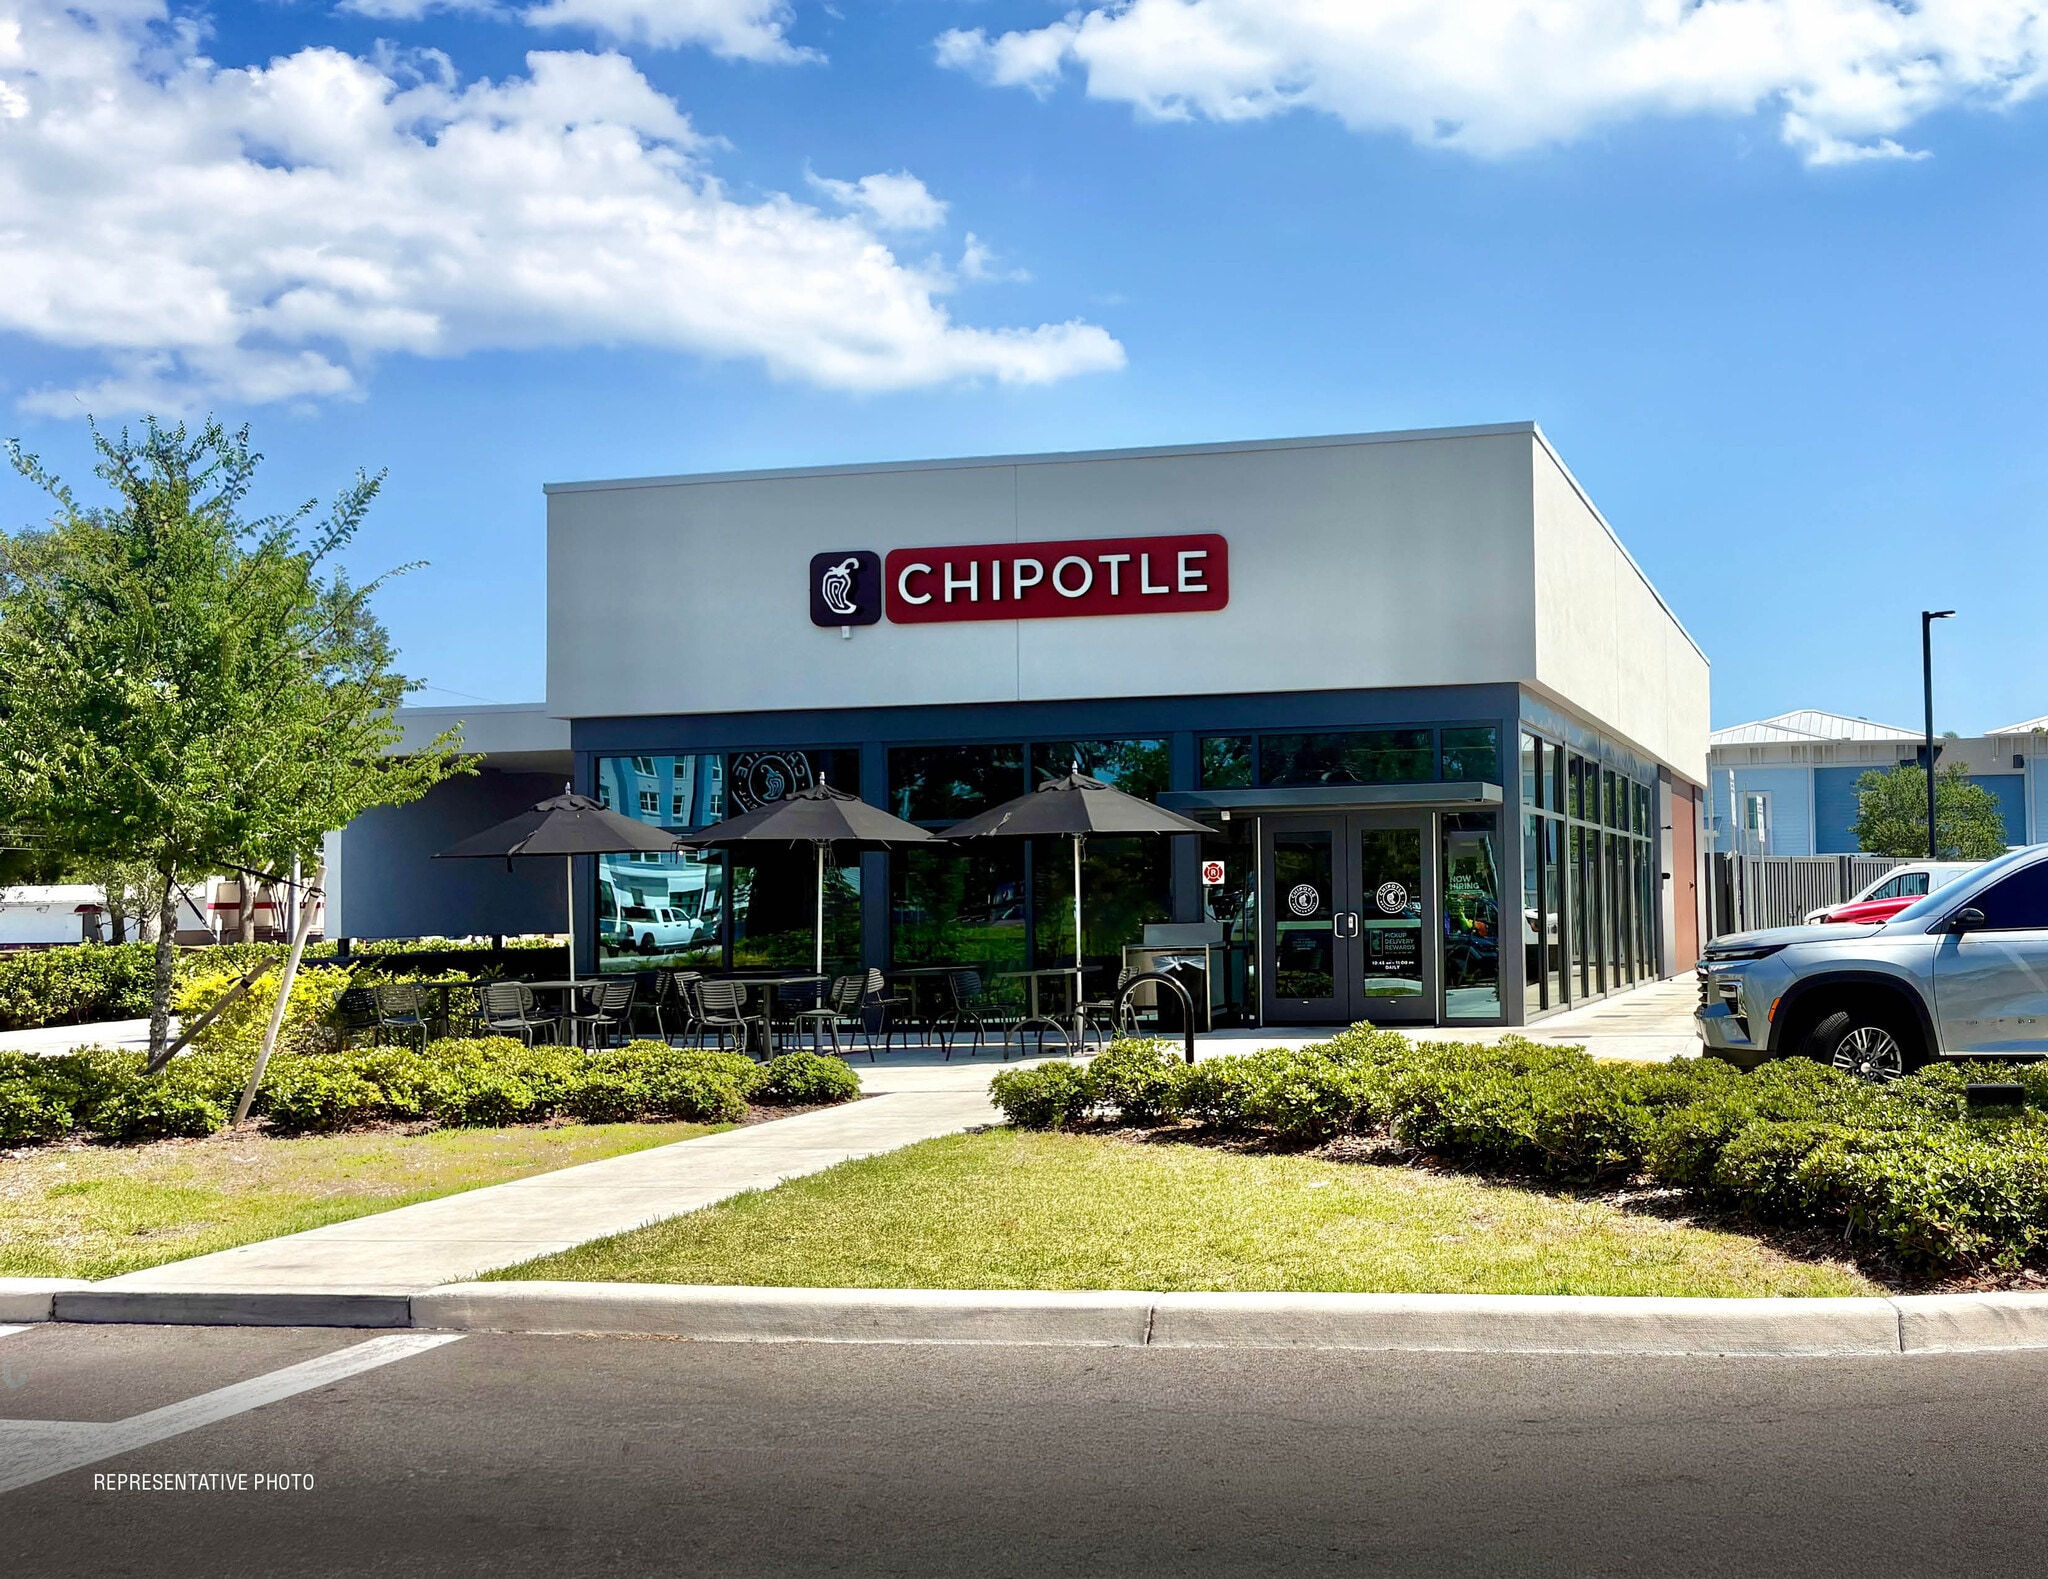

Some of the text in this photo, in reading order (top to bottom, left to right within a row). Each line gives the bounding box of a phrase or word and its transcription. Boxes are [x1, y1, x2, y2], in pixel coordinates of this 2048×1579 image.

[898, 550, 1208, 605] CHIPOTLE
[1450, 875, 1472, 883] NOW
[1450, 882, 1480, 890] HIRING
